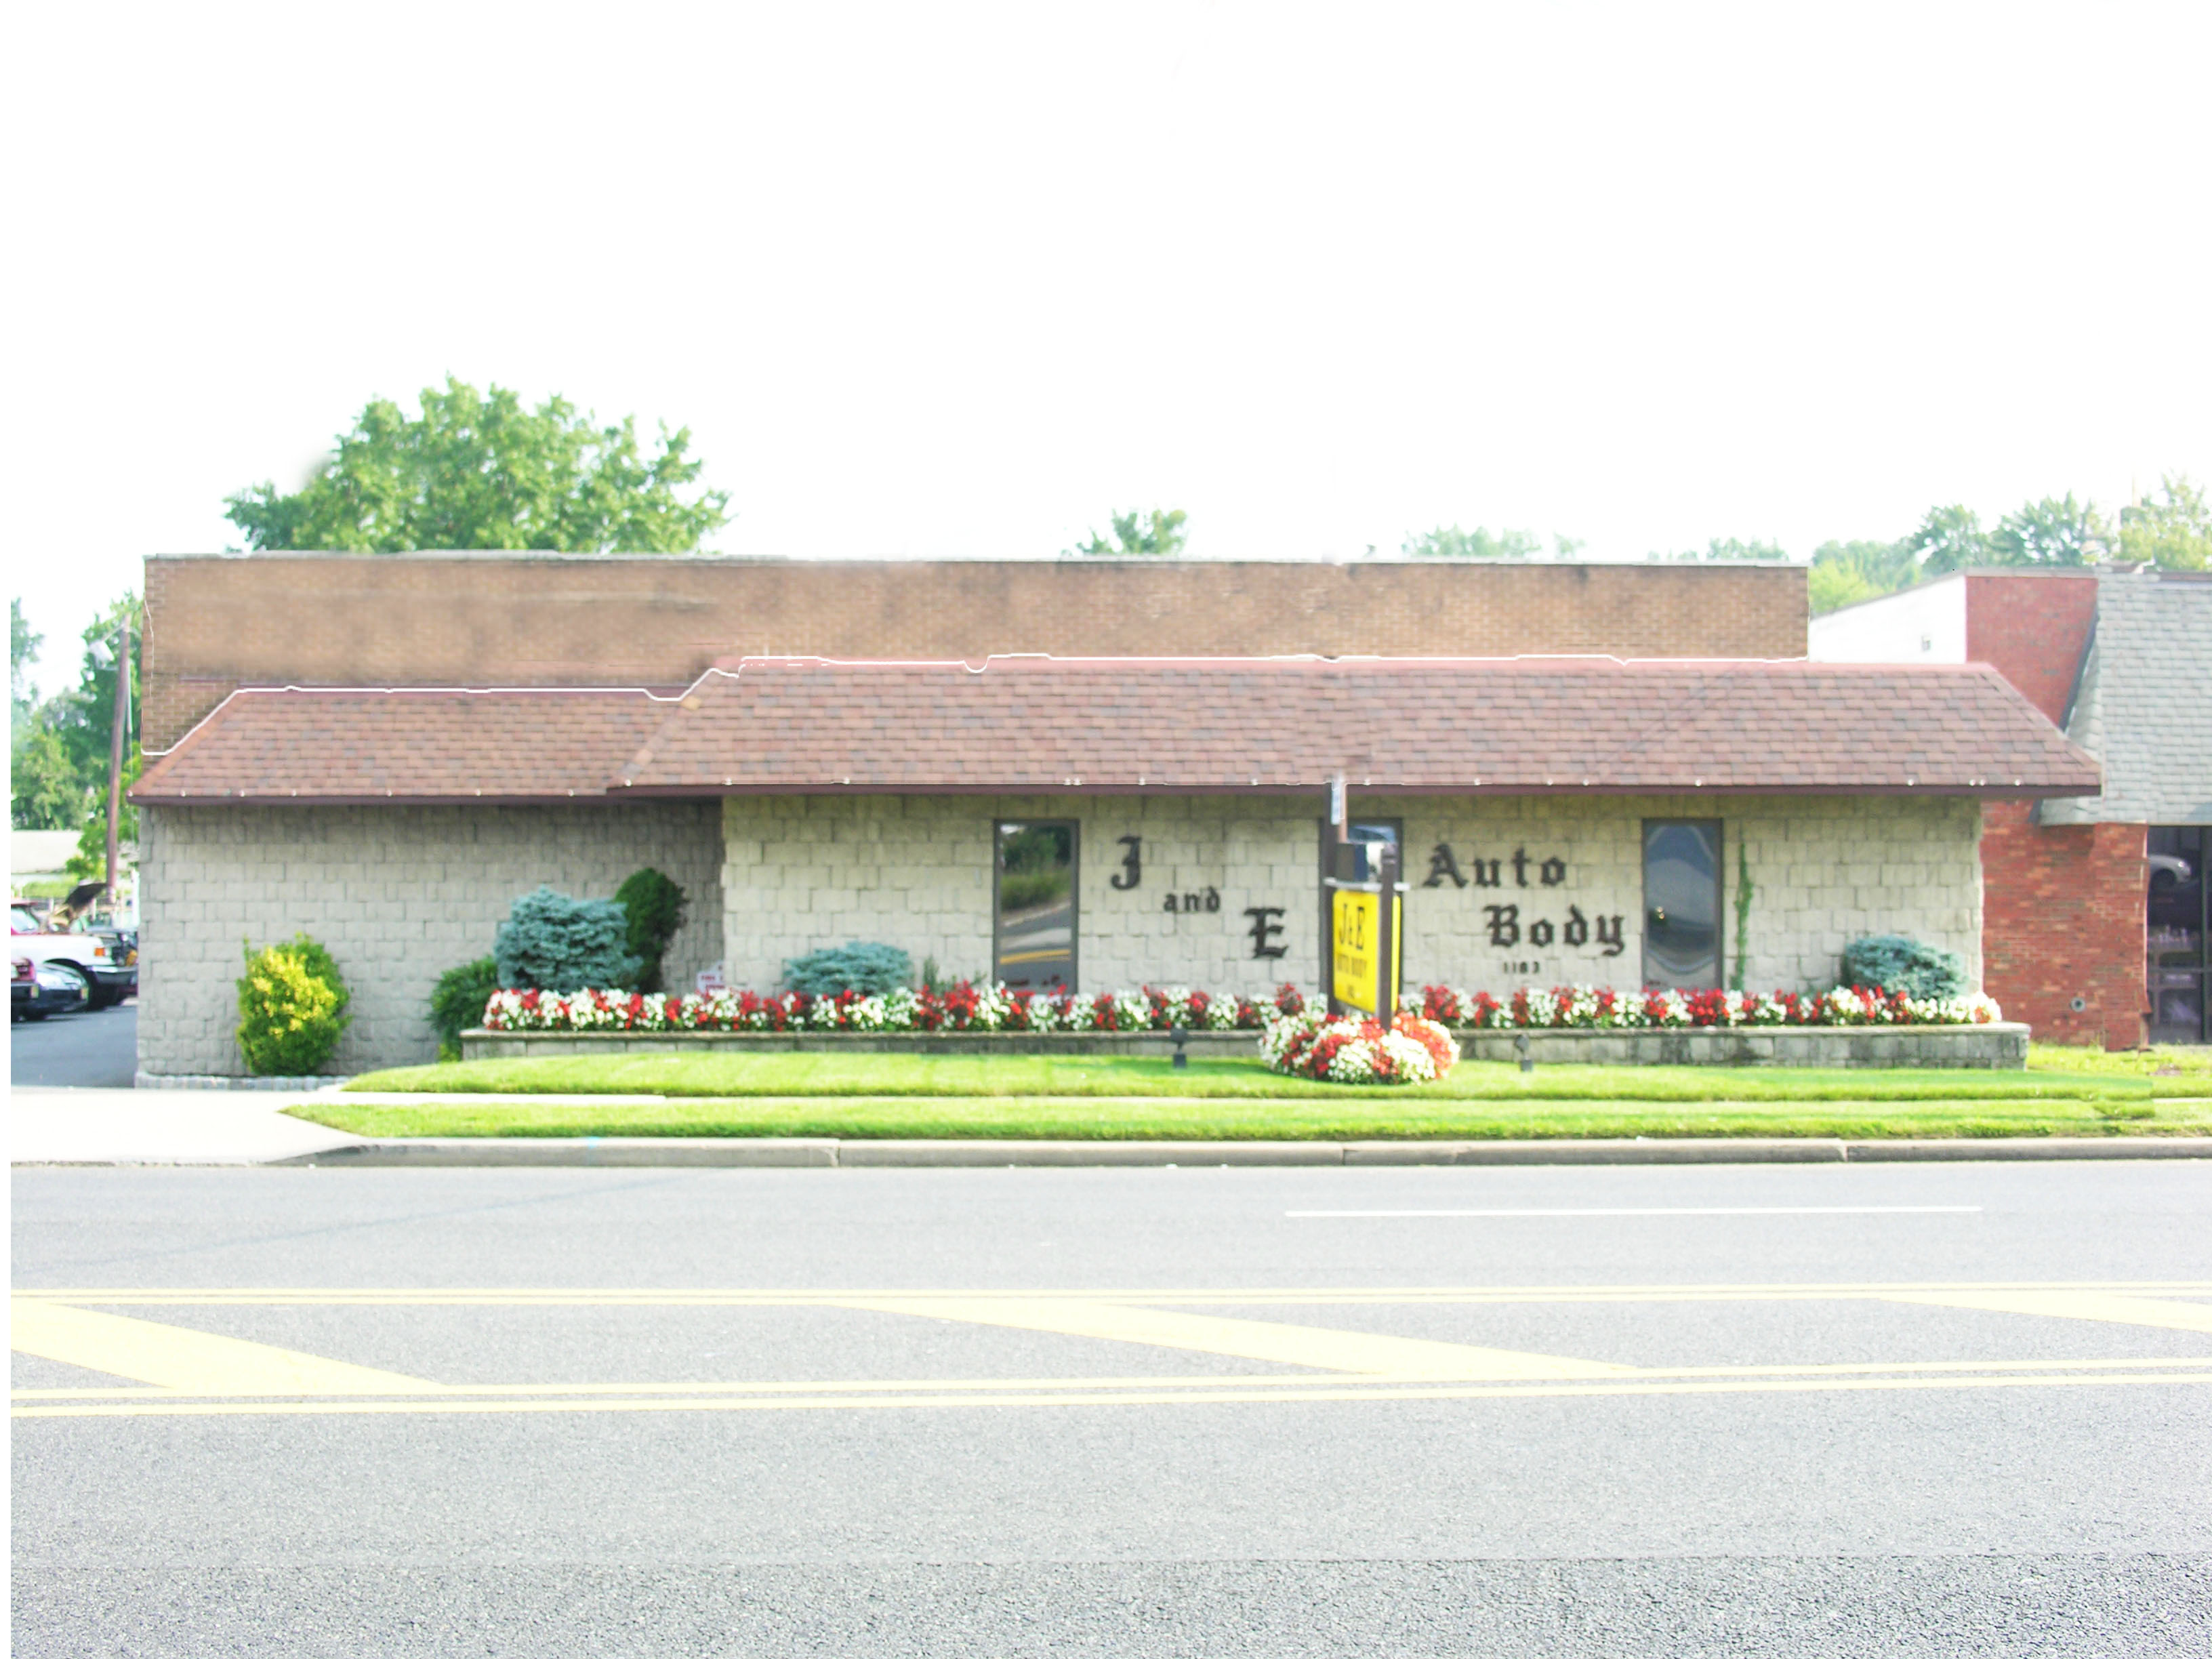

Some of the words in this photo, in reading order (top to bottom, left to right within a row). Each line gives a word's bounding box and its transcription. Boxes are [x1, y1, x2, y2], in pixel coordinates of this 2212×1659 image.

[1110, 834, 1143, 890] J
[1423, 842, 1567, 889] Auto
[1163, 886, 1221, 913] and
[1244, 907, 1288, 959] E
[1484, 904, 1625, 957] Body
